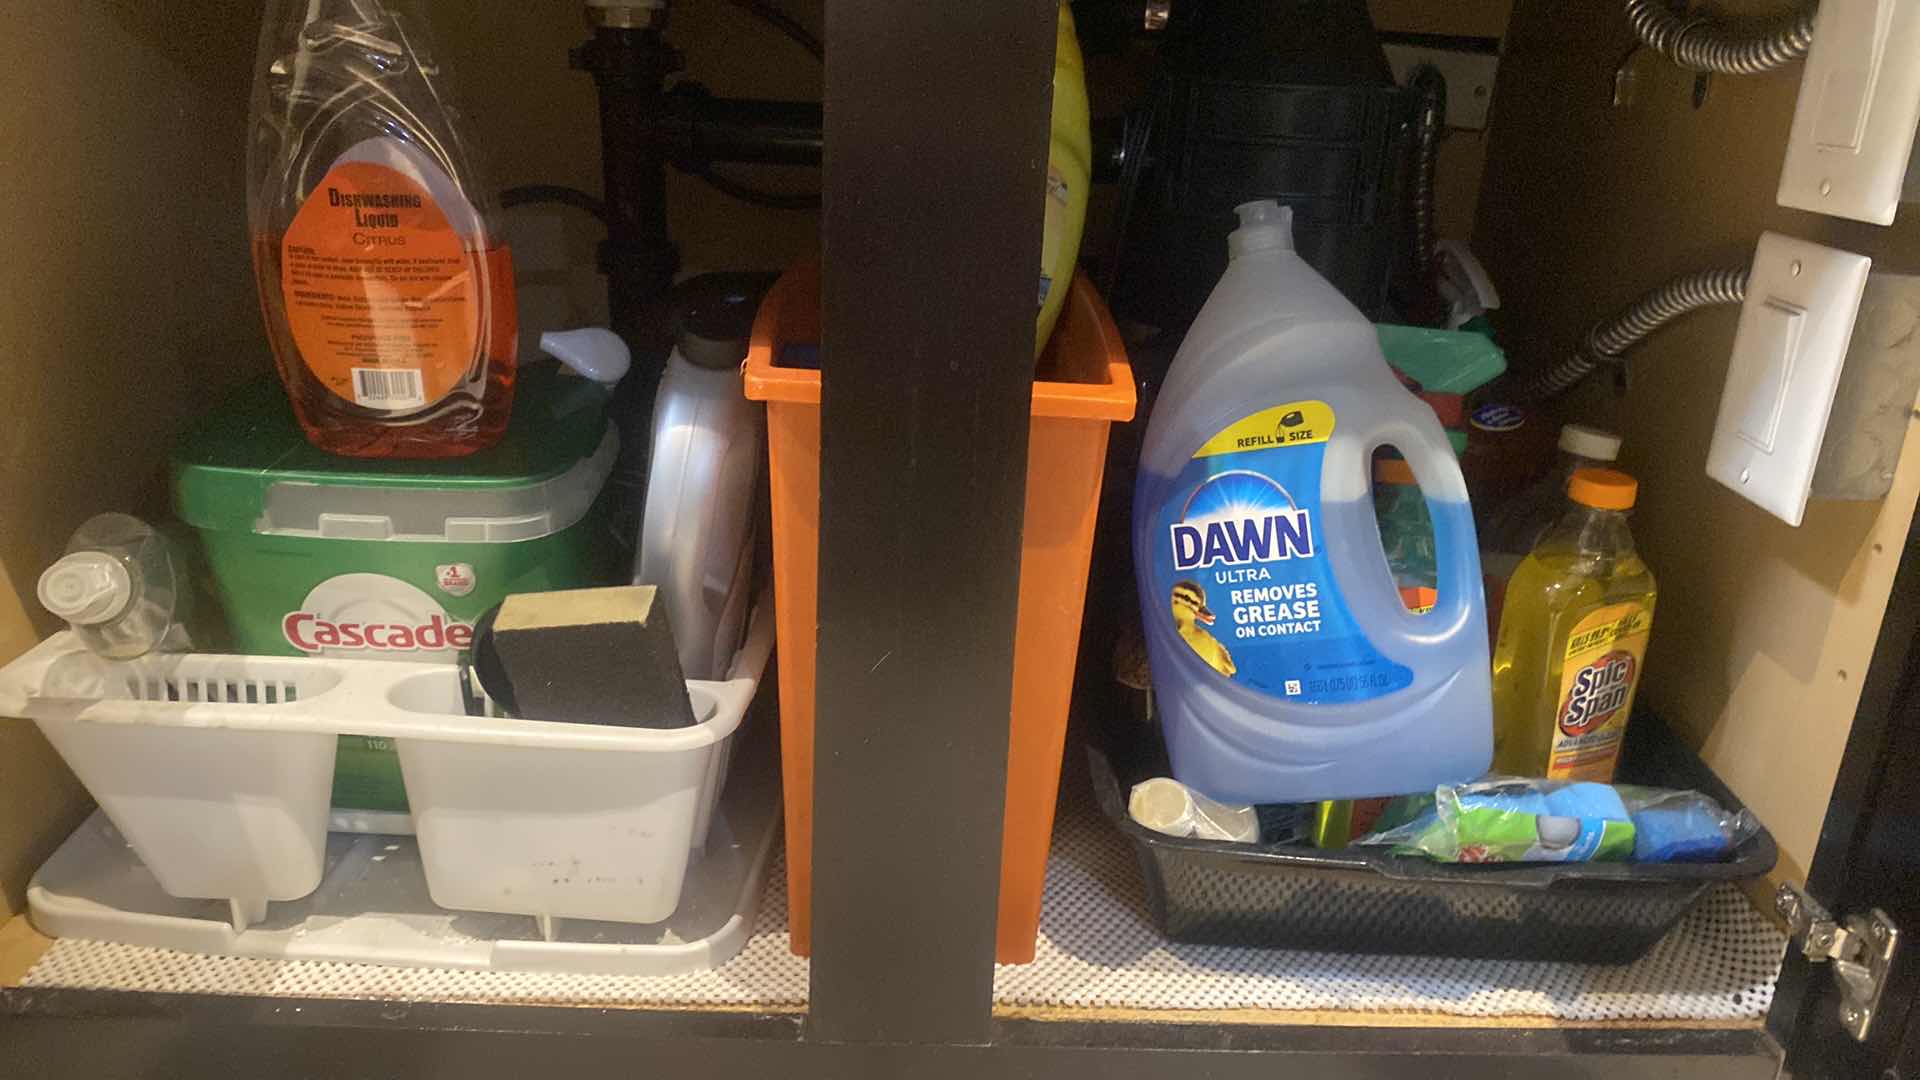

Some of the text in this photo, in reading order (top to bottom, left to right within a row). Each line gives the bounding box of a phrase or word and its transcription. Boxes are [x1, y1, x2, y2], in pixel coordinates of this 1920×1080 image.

[1237, 430, 1314, 448] REFILL SIZE
[1173, 514, 1311, 568] DAWN
[1215, 569, 1272, 584] ULTRA
[1231, 583, 1317, 605] REMOVES
[1233, 600, 1320, 624] GREASE
[283, 612, 473, 651] Cascade
[1235, 620, 1321, 638] ON CONTACT
[1575, 662, 1626, 696] Spic
[1566, 686, 1627, 724] Span
